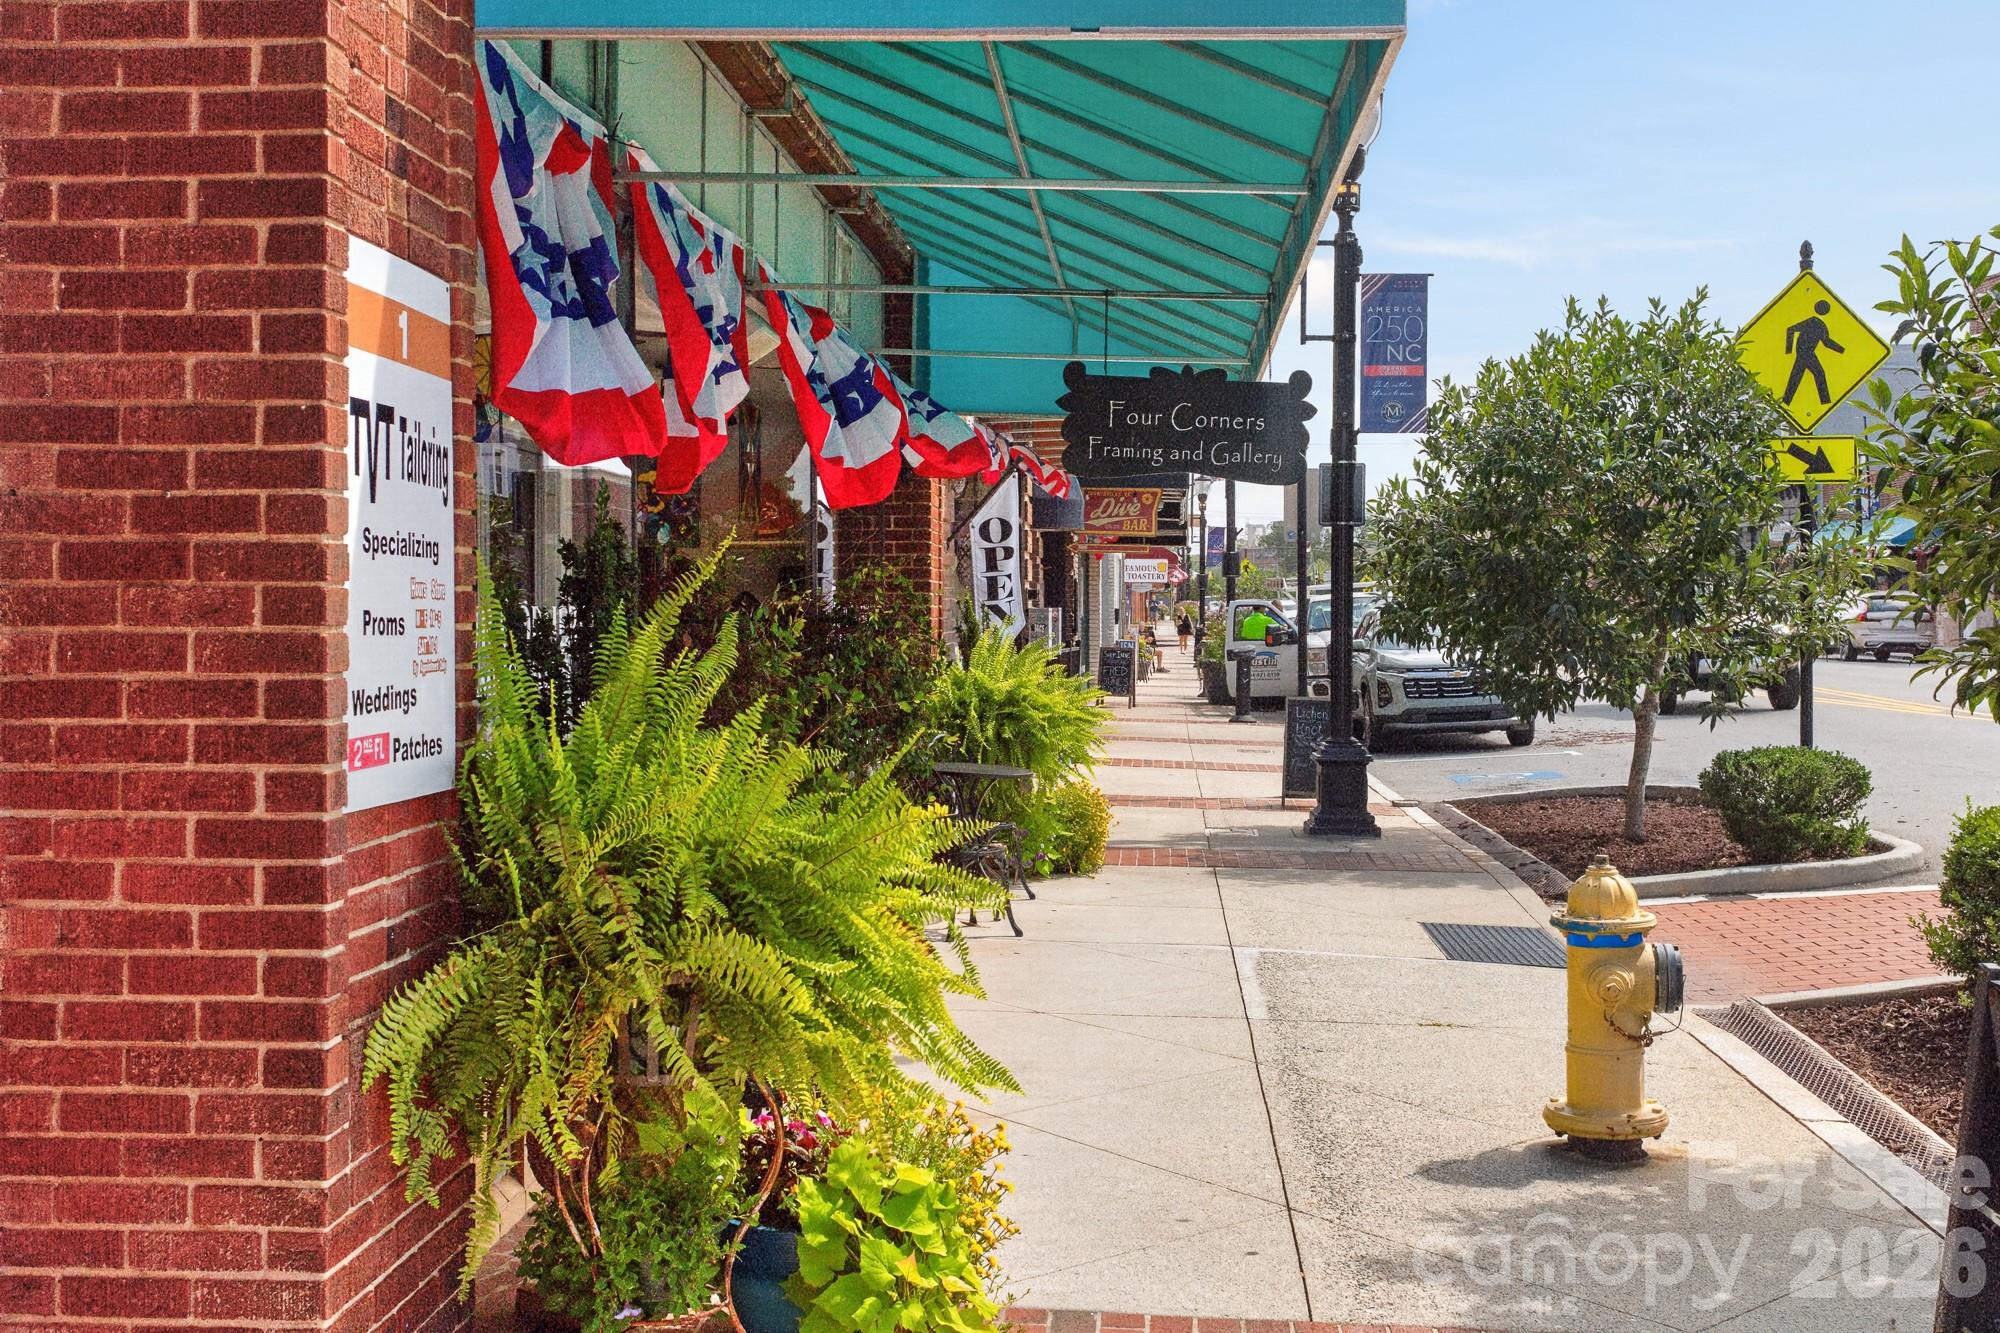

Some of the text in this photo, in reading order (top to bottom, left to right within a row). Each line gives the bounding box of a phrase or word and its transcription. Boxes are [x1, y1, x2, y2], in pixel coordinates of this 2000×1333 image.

[1368, 305, 1422, 313] AMERICA
[399, 310, 408, 360] 1
[1366, 315, 1424, 343] 250
[1387, 344, 1422, 362] NC
[1109, 400, 1266, 431] Four Corners
[350, 396, 449, 507] TVT Tailoring
[1088, 436, 1282, 472] Framing and Gallery
[1090, 497, 1141, 518] Dive
[1122, 518, 1148, 531] BAR
[363, 527, 440, 565] Specializing
[1125, 564, 1157, 572] FAMOUS
[1127, 572, 1166, 580] TOASTERY
[363, 609, 405, 637] Proms
[1103, 665, 1129, 677] FRED
[1250, 656, 1278, 666] ustin
[351, 685, 417, 716] Weddings
[393, 733, 443, 763] Patches
